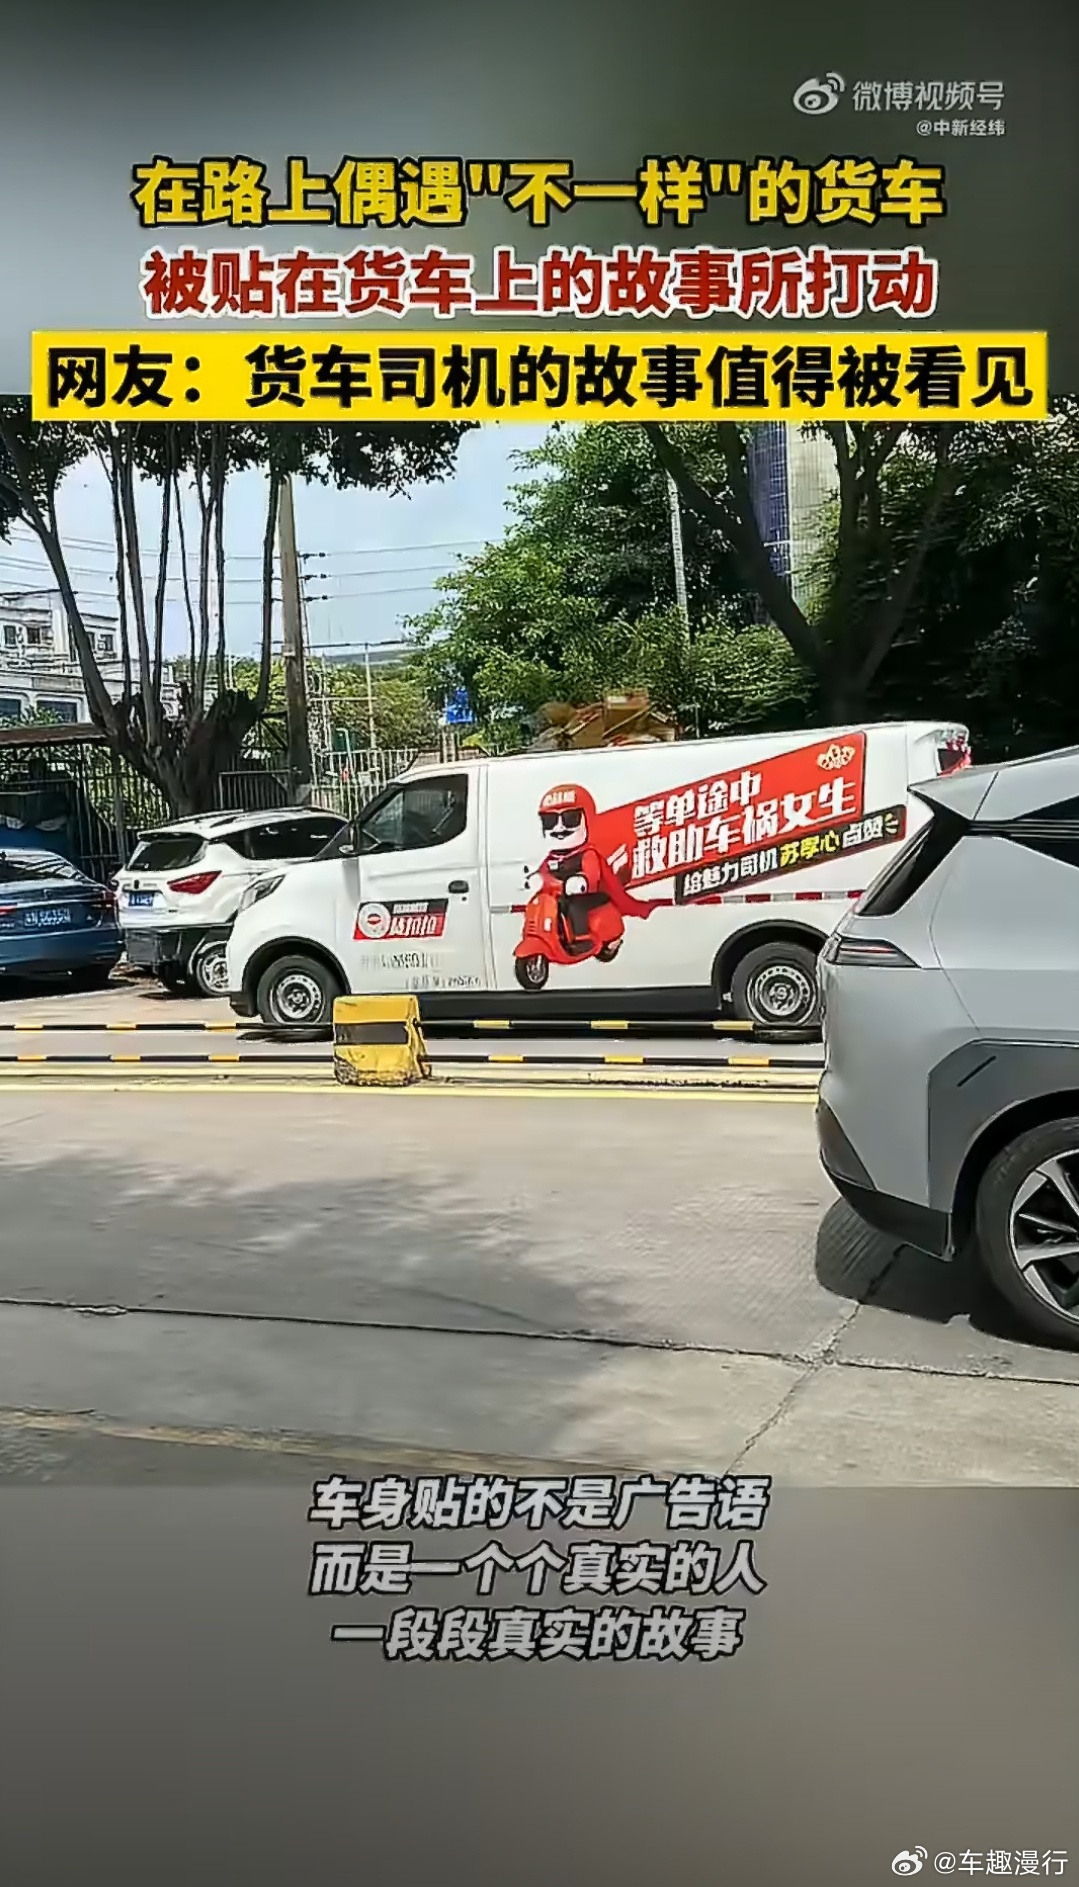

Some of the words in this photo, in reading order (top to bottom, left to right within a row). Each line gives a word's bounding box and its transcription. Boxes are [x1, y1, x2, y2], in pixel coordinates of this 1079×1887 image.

[631, 776, 858, 879] 救助车祸女生
[633, 770, 762, 837] 等单途中
